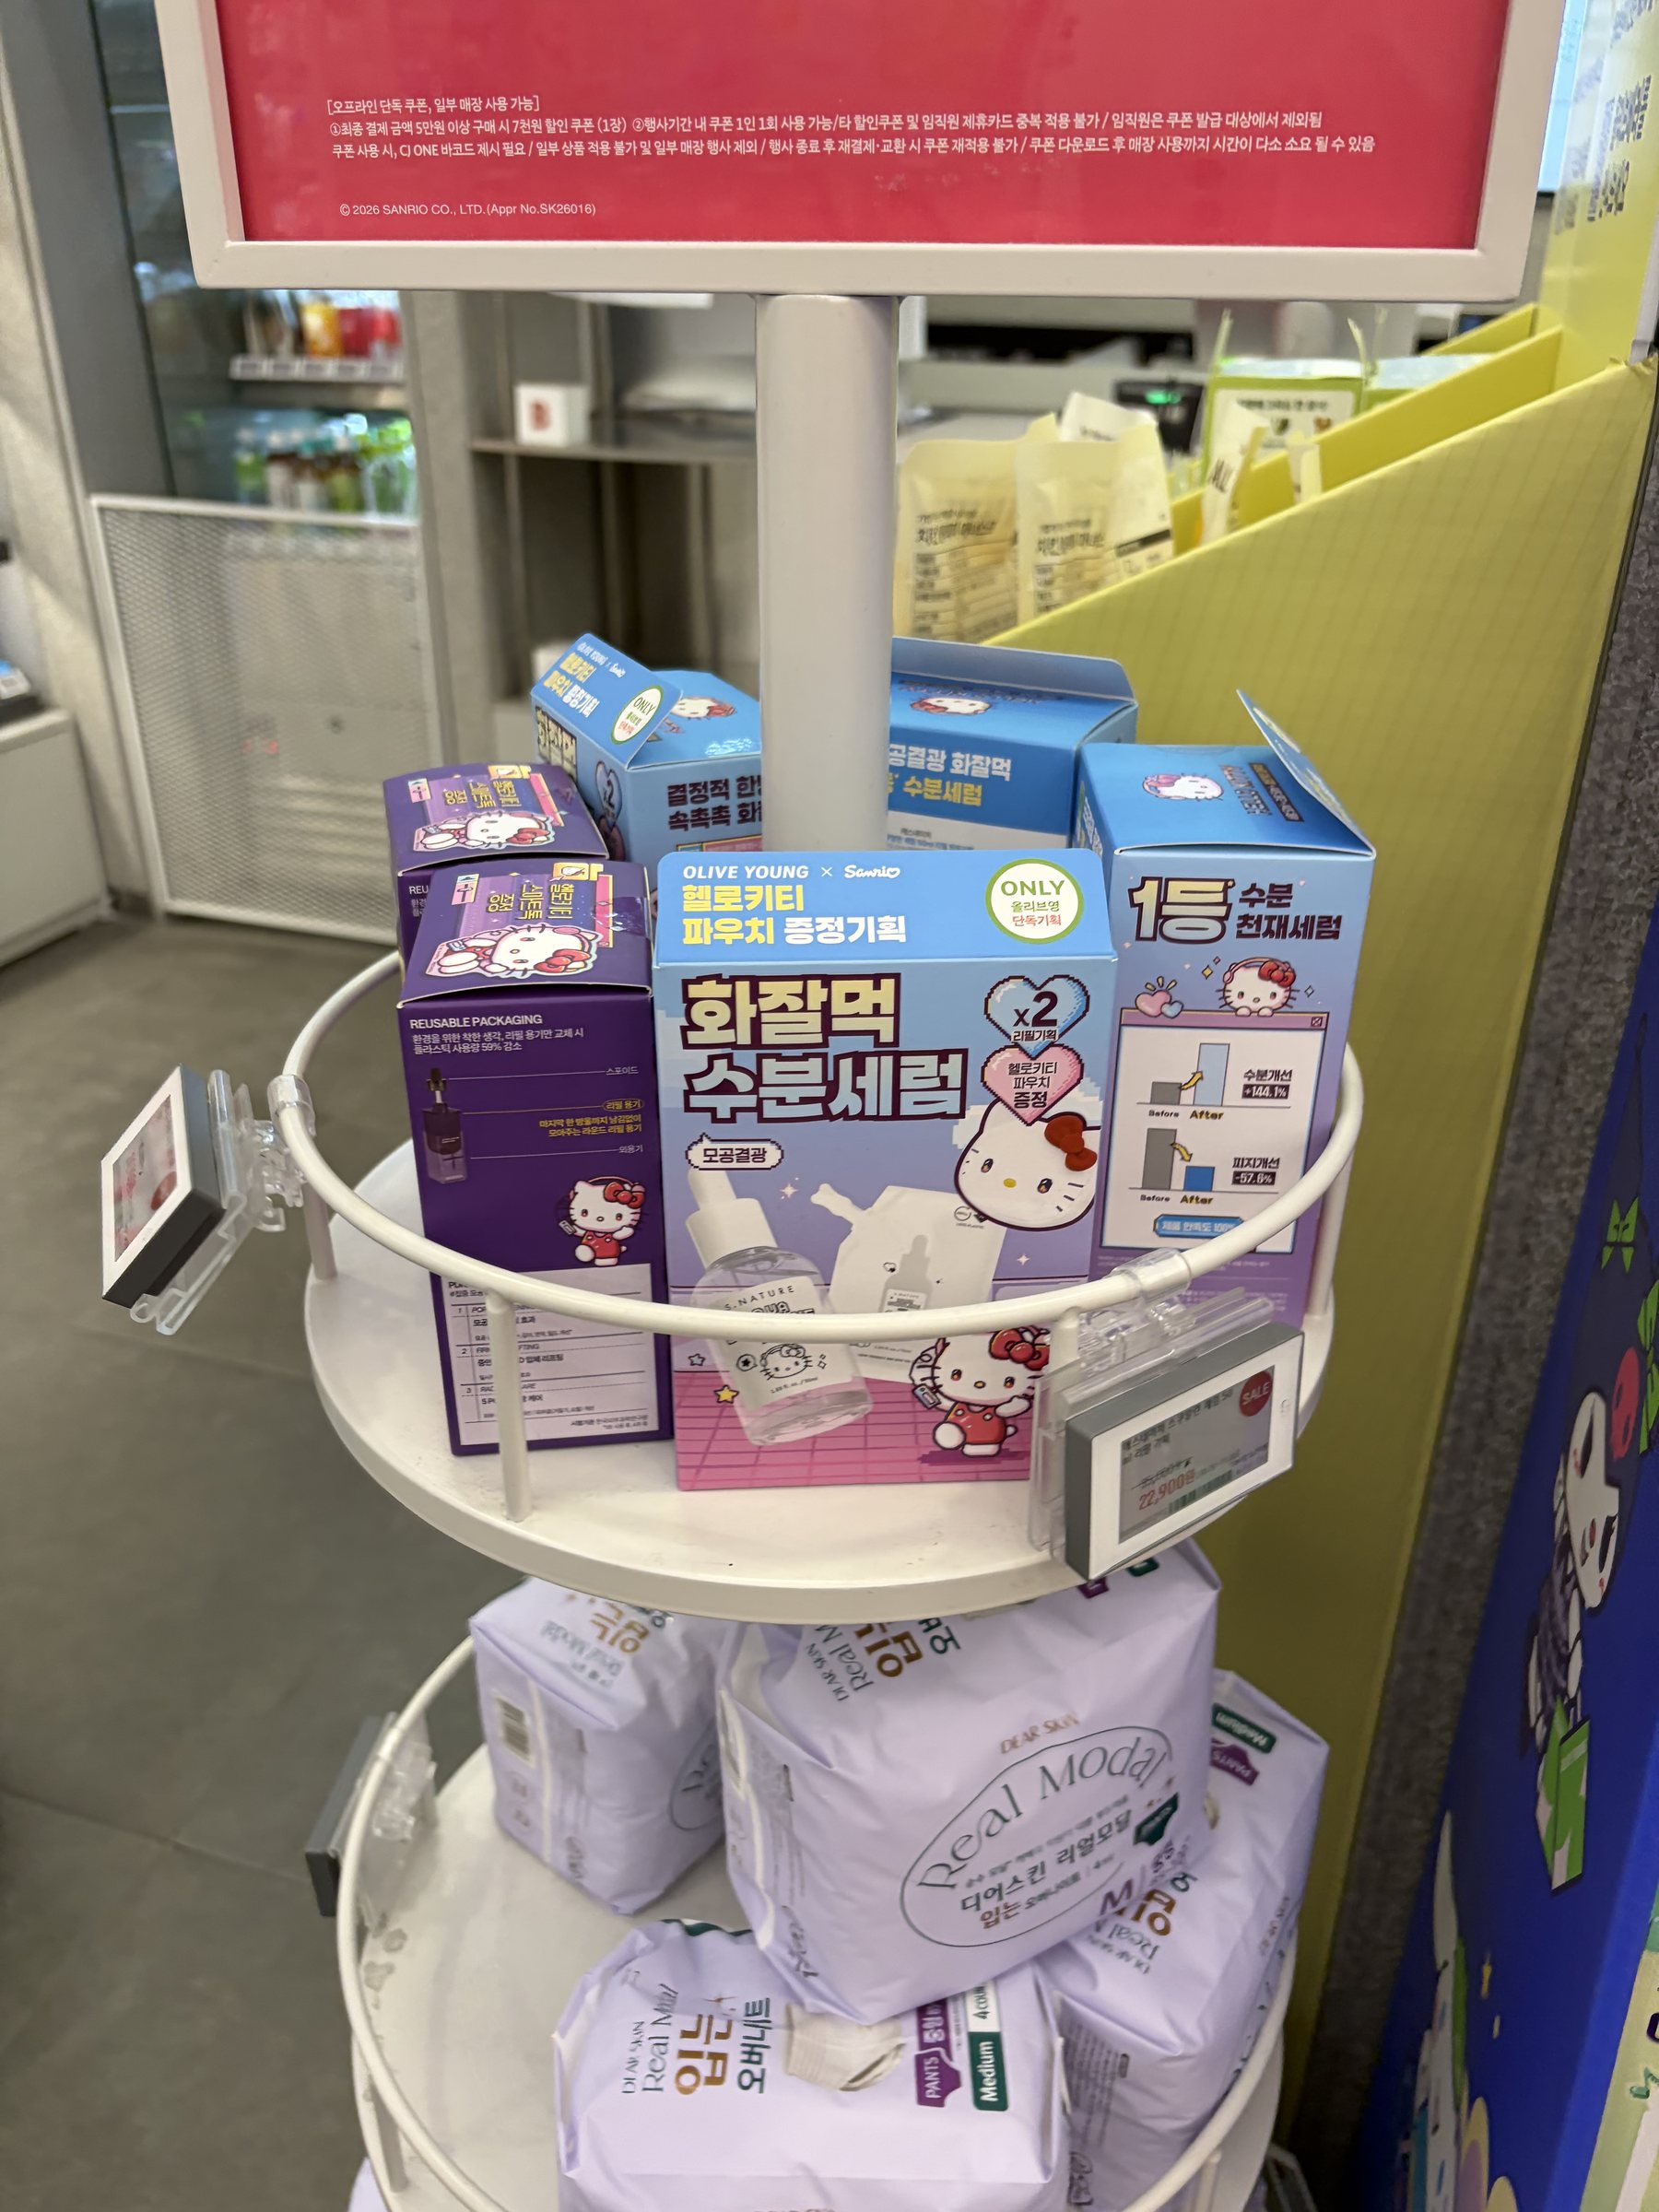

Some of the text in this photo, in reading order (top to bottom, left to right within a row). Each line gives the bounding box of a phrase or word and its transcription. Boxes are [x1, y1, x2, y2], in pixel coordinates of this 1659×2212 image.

[326, 95, 540, 114] [오프라인 단독 쿠폰, 일부 매장 사용 가능]
[365, 121, 389, 136] 결제
[390, 120, 414, 136] 금액
[416, 120, 445, 135] 5만원
[447, 119, 471, 135] 이상
[472, 119, 496, 135] 구매
[498, 119, 510, 135] 시
[513, 118, 543, 135] 7천원
[545, 118, 569, 134] 할인
[571, 118, 594, 134] 쿠폰
[597, 117, 627, 134] (1장)
[694, 116, 707, 132] 내
[709, 116, 734, 133] 쿠폰
[736, 116, 756, 132] 1인
[759, 116, 778, 132] 1회
[781, 115, 806, 132] 사용
[853, 114, 904, 131] 할인쿠폰
[906, 114, 919, 130] 및
[922, 114, 959, 131] 임직원
[962, 113, 1014, 130] 제휴카드
[1016, 113, 1042, 130] 중복
[1044, 113, 1071, 130] 적용
[1073, 112, 1100, 129] 불가
[1112, 112, 1165, 130] 임직원은
[1166, 112, 1194, 129] 쿠폰
[1195, 112, 1223, 129] 발급
[1225, 111, 1279, 129] 대상에서
[1281, 111, 1323, 128] 제외됨
[332, 144, 356, 159] 쿠폰
[357, 143, 380, 159] 사용
[382, 143, 397, 159] 시,
[399, 144, 411, 158] CJ
[413, 144, 440, 157] ONE
[441, 142, 476, 158] 바코드
[477, 141, 500, 157] 제시
[502, 141, 526, 157] 필요
[535, 141, 560, 157] 일부
[561, 140, 585, 157] 상품
[587, 140, 611, 157] 적용
[613, 140, 638, 156] 불가
[640, 140, 652, 156] 및
[653, 140, 678, 156] 일부
[680, 139, 705, 156] 매장
[707, 139, 732, 156] 행사
[733, 139, 758, 156] 제외
[769, 139, 794, 155] 행사
[795, 138, 821, 155] 종료
[822, 138, 836, 155] 후
[909, 137, 921, 154] 시
[924, 137, 949, 154] 쿠폰
[951, 137, 990, 154] 재적용
[992, 137, 1018, 154] 불가
[1029, 136, 1056, 154] 쿠폰
[1058, 136, 1110, 154] 다운로드
[1112, 136, 1126, 153] 후
[1128, 136, 1156, 153] 매장
[1157, 135, 1210, 153] 사용까지
[1212, 135, 1253, 153] 시간이
[1255, 135, 1282, 152] 다소
[1284, 136, 1312, 151] 소요
[1314, 135, 1329, 153] 될
[1331, 135, 1346, 153] 수
[1348, 135, 1375, 153] 있음
[352, 204, 380, 215] 2026
[382, 204, 428, 215] SANRIO
[430, 204, 456, 217] CO.,
[520, 202, 596, 216] No.SK26016)
[633, 697, 656, 716] ONLY
[949, 751, 1012, 782] 화잘먹
[667, 778, 730, 807] 결정적
[903, 775, 982, 806] 수분세럼
[668, 805, 731, 831] 속촉촉
[683, 865, 738, 879] OLIVE
[744, 865, 809, 879] YOUNG
[682, 884, 805, 912] 헬로키티
[1000, 879, 1065, 897] ONLY
[1239, 883, 1293, 908] 수분
[488, 892, 515, 914] 증정
[518, 883, 545, 922] 스마트톡
[547, 882, 575, 920] 헬로키티
[1011, 900, 1060, 913] 올리브영
[682, 914, 907, 945] 파우치 증정기획
[1012, 913, 1062, 927] 단독기획
[1236, 914, 1343, 941] 천재세럼
[409, 1014, 543, 1030] REUSABLE PACKAGING
[681, 973, 901, 1050] 화잘먹
[1013, 991, 1059, 1028] x2
[412, 1033, 441, 1044] 환경을
[441, 1032, 461, 1043] 위한
[463, 1031, 481, 1042] 착한
[505, 1030, 524, 1041] 리필
[524, 1029, 553, 1040] 용기만
[554, 1028, 573, 1039] 교체
[574, 1027, 584, 1038] 시
[453, 1041, 480, 1053] 사용량
[481, 1041, 502, 1052] 59%
[503, 1041, 524, 1051] 감소
[1013, 1030, 1057, 1042] 리필기획
[1008, 1062, 1058, 1077] 헬로키티
[1242, 1069, 1293, 1082] 수분개선
[684, 1048, 969, 1124] 수분세럼
[1013, 1077, 1051, 1090] 파우치
[1243, 1086, 1288, 1099] +144.1%
[1014, 1091, 1049, 1110] 증정
[1148, 1110, 1224, 1121] Before After
[702, 1147, 768, 1164] 모공결광
[1231, 1157, 1280, 1170] 피지개선
[1234, 1172, 1273, 1184] -57.6%
[1139, 1194, 1213, 1206] Before After
[724, 1285, 794, 1312] S.NATURE
[1241, 1382, 1271, 1406] SALE
[1138, 1468, 1196, 1511] 22,900원
[828, 1643, 875, 1691] Real
[1000, 1724, 1041, 1754] DEAR
[916, 1736, 1169, 1889] Real Modal
[960, 1808, 1133, 1912] 디어스킨 리얼모달
[980, 1901, 1022, 1930] 입는
[675, 2013, 734, 2095] 입는
[736, 1997, 774, 2095] 오버나이트
[641, 2035, 670, 2092] Real
[977, 2041, 1000, 2102] Medium
[923, 2056, 942, 2100] PANTS
